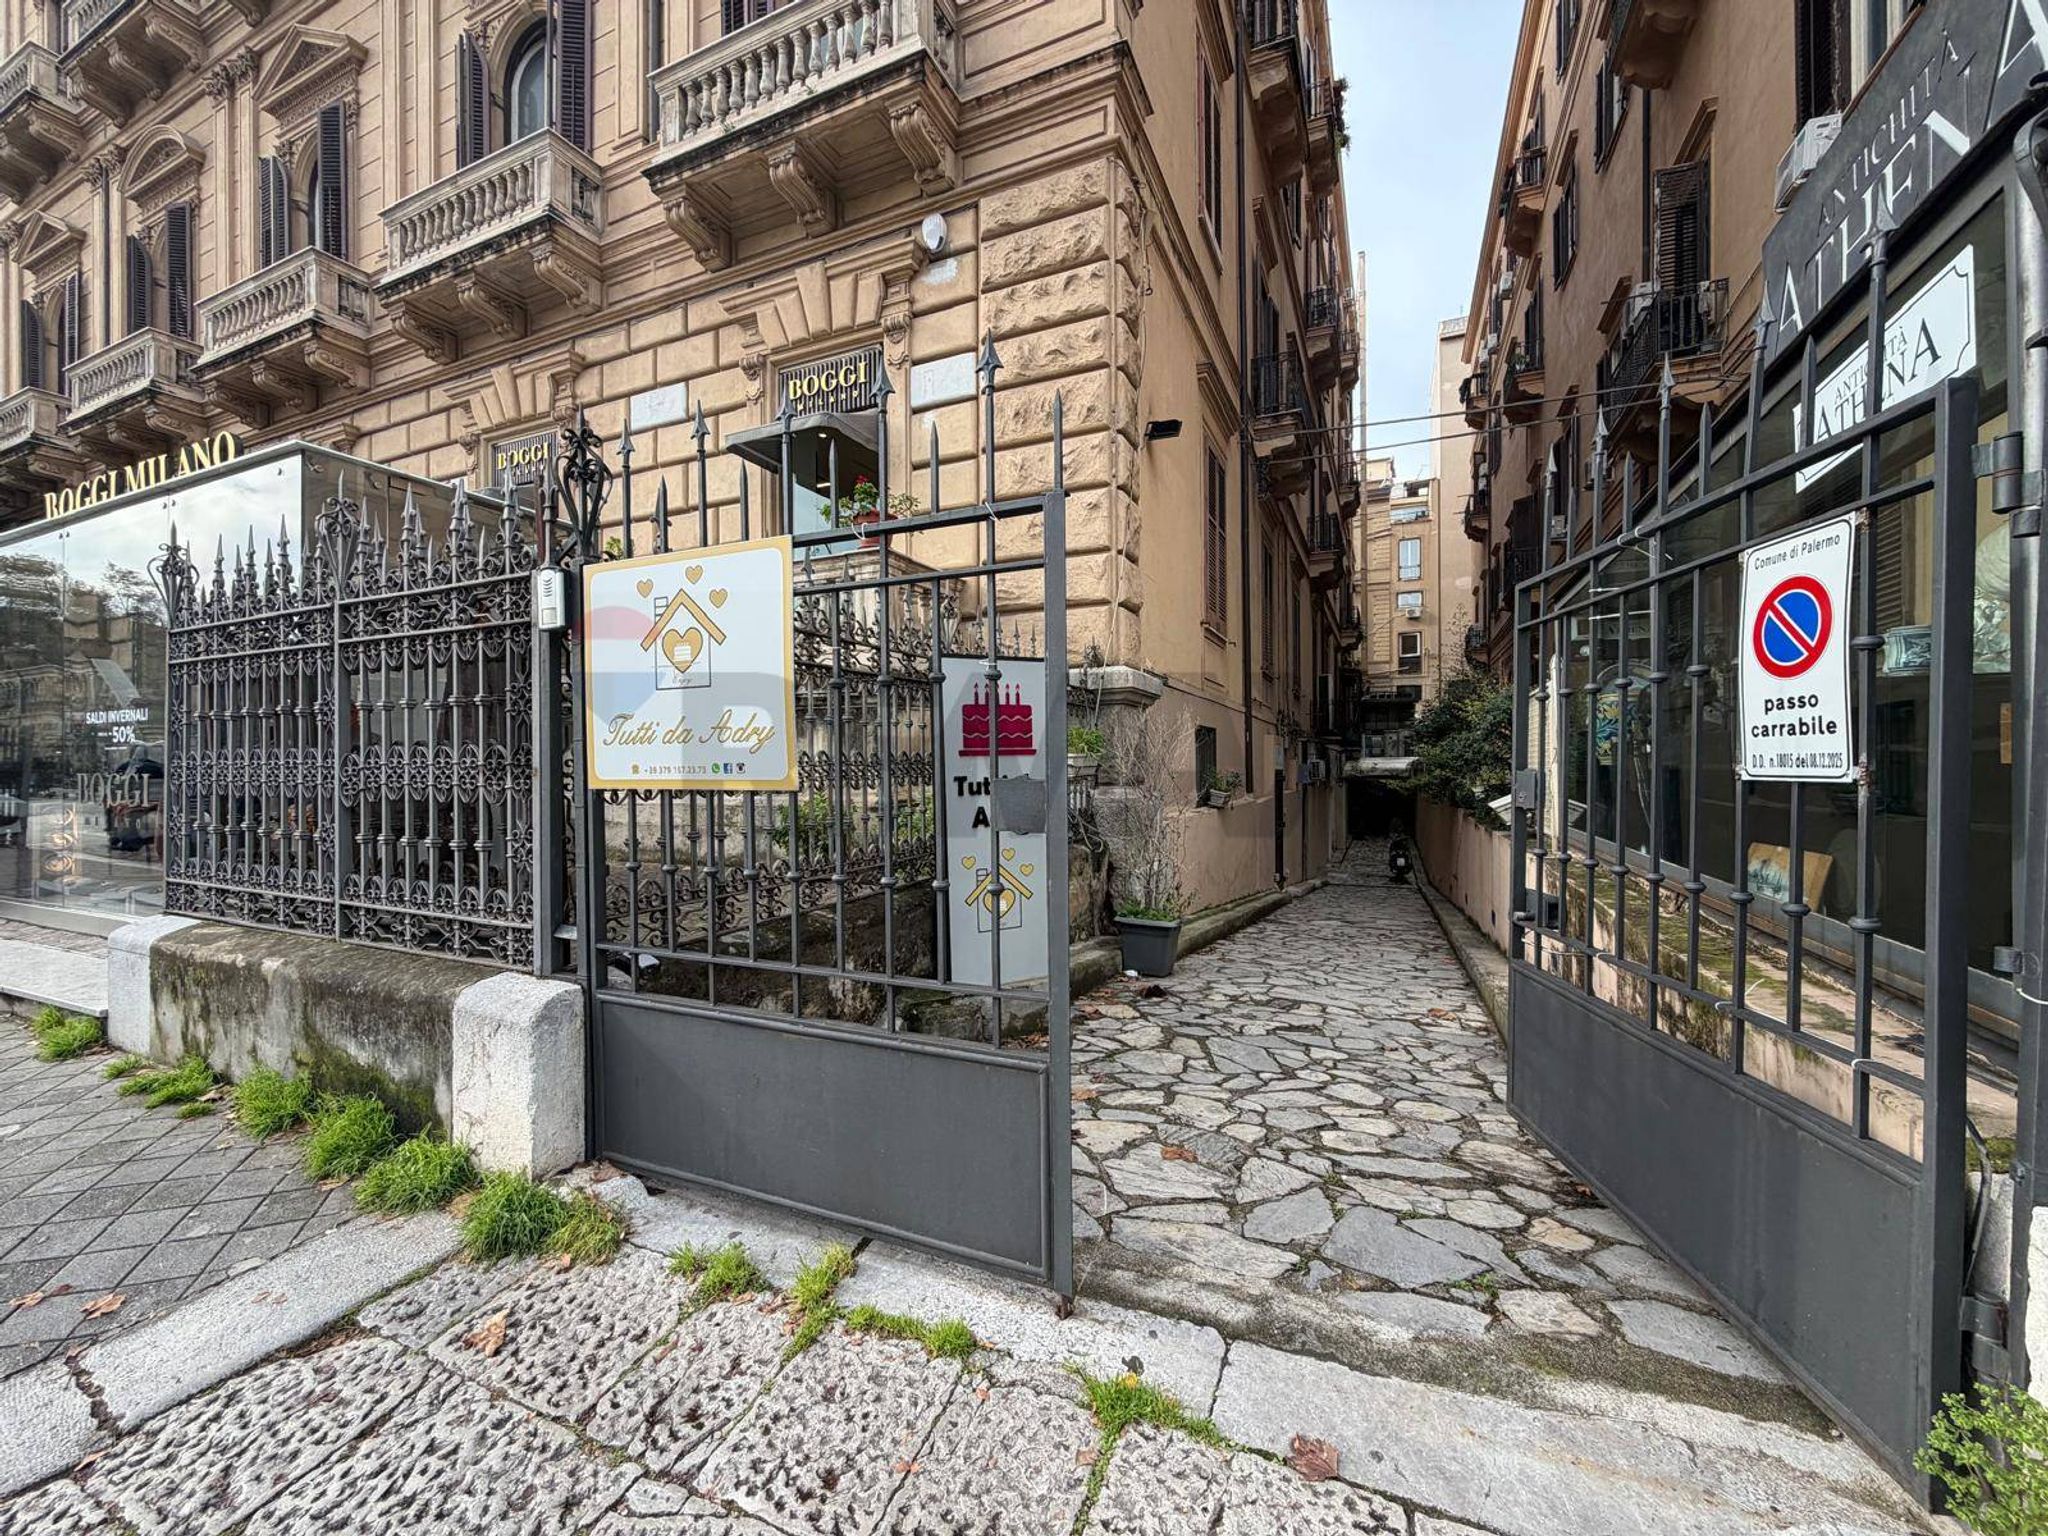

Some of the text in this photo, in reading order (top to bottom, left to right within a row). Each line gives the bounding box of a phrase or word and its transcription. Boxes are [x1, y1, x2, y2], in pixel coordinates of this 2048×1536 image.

[788, 361, 870, 400] BOGGI
[1817, 317, 1942, 440] ATHNA
[497, 441, 549, 470] BOGGI
[44, 430, 236, 520] BOGGI MILANO
[1754, 534, 1841, 570] Comune di Palermo
[85, 708, 149, 725] SALDI INVERNALI
[1764, 694, 1819, 715] passo
[602, 708, 776, 754] Tutti da Adry
[1751, 715, 1838, 738] carrabile
[77, 772, 152, 808] BOGGI
